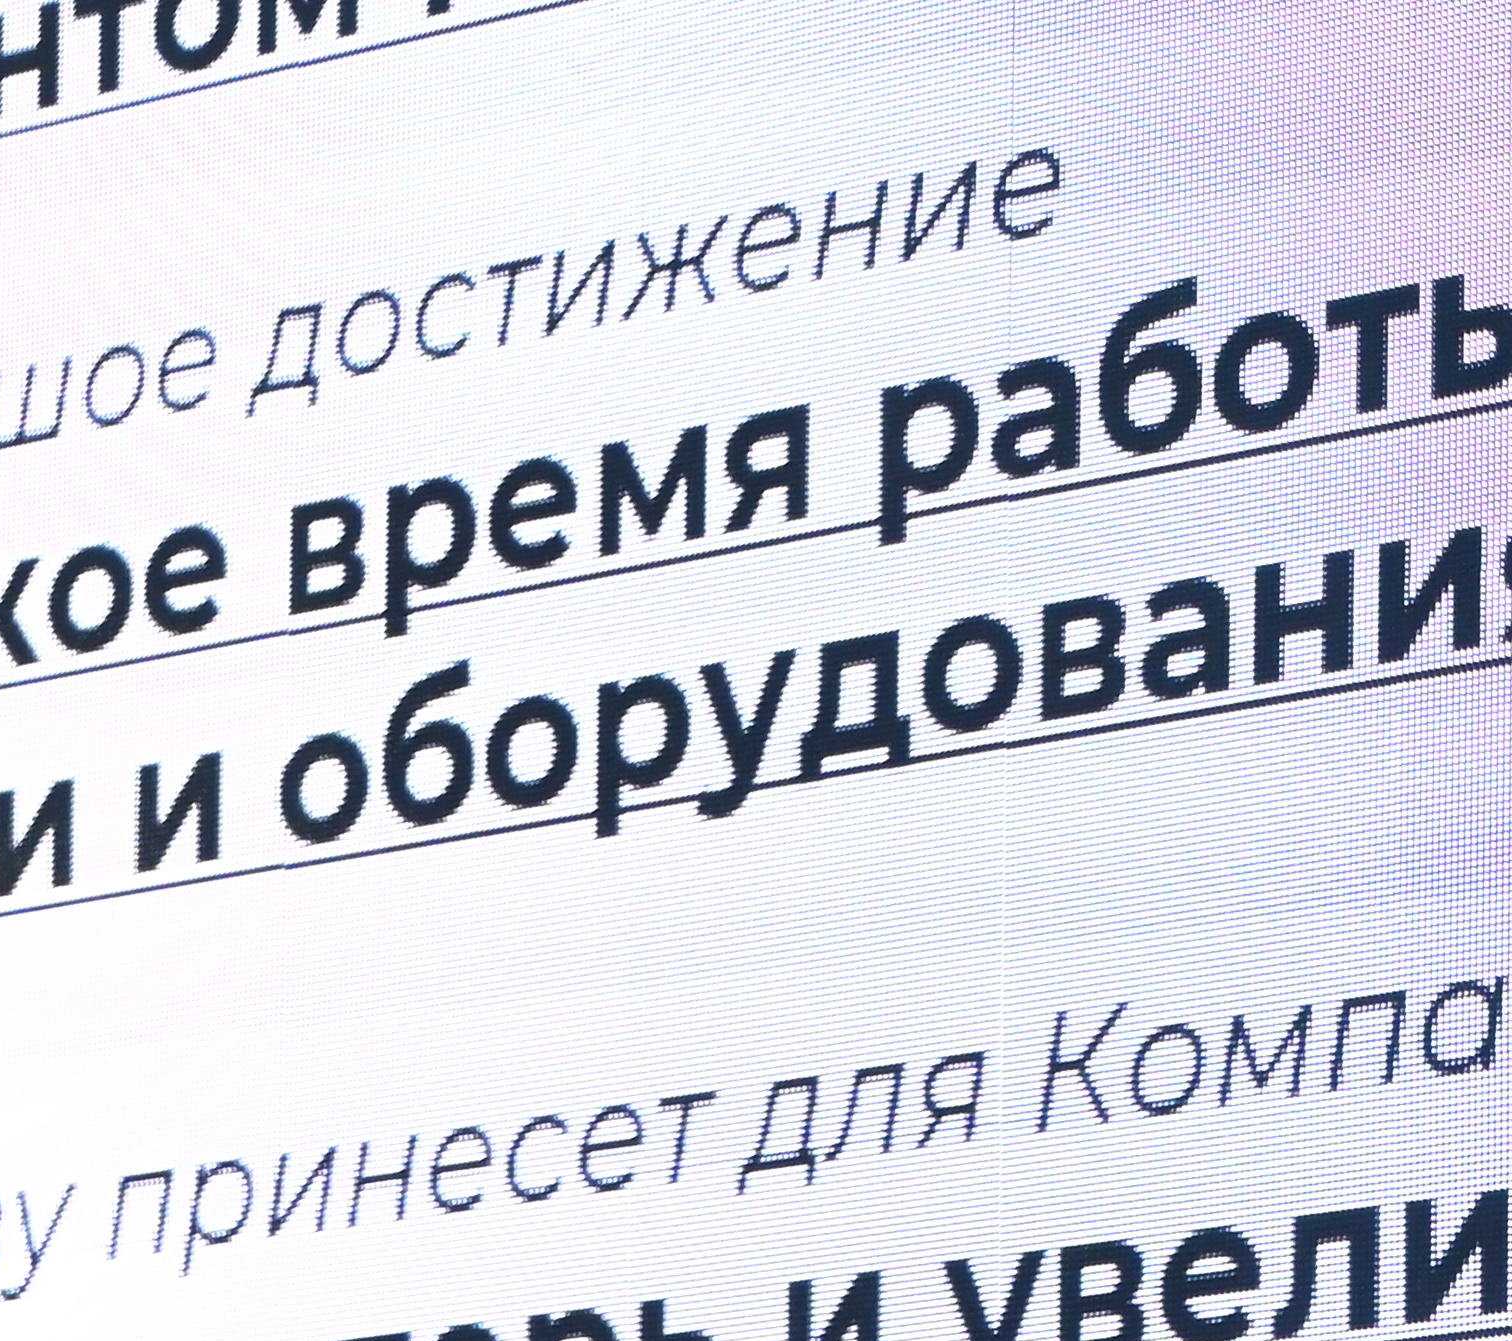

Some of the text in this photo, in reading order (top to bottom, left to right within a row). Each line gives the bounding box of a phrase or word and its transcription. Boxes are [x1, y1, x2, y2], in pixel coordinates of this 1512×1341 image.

[246, 146, 1062, 417] достижение
[289, 404, 810, 637] время
[133, 751, 223, 874] и
[278, 526, 1512, 839] оборудовани
[107, 1090, 717, 1276] принесет
[737, 1050, 987, 1195] для
[1036, 975, 1505, 1132] Компа
